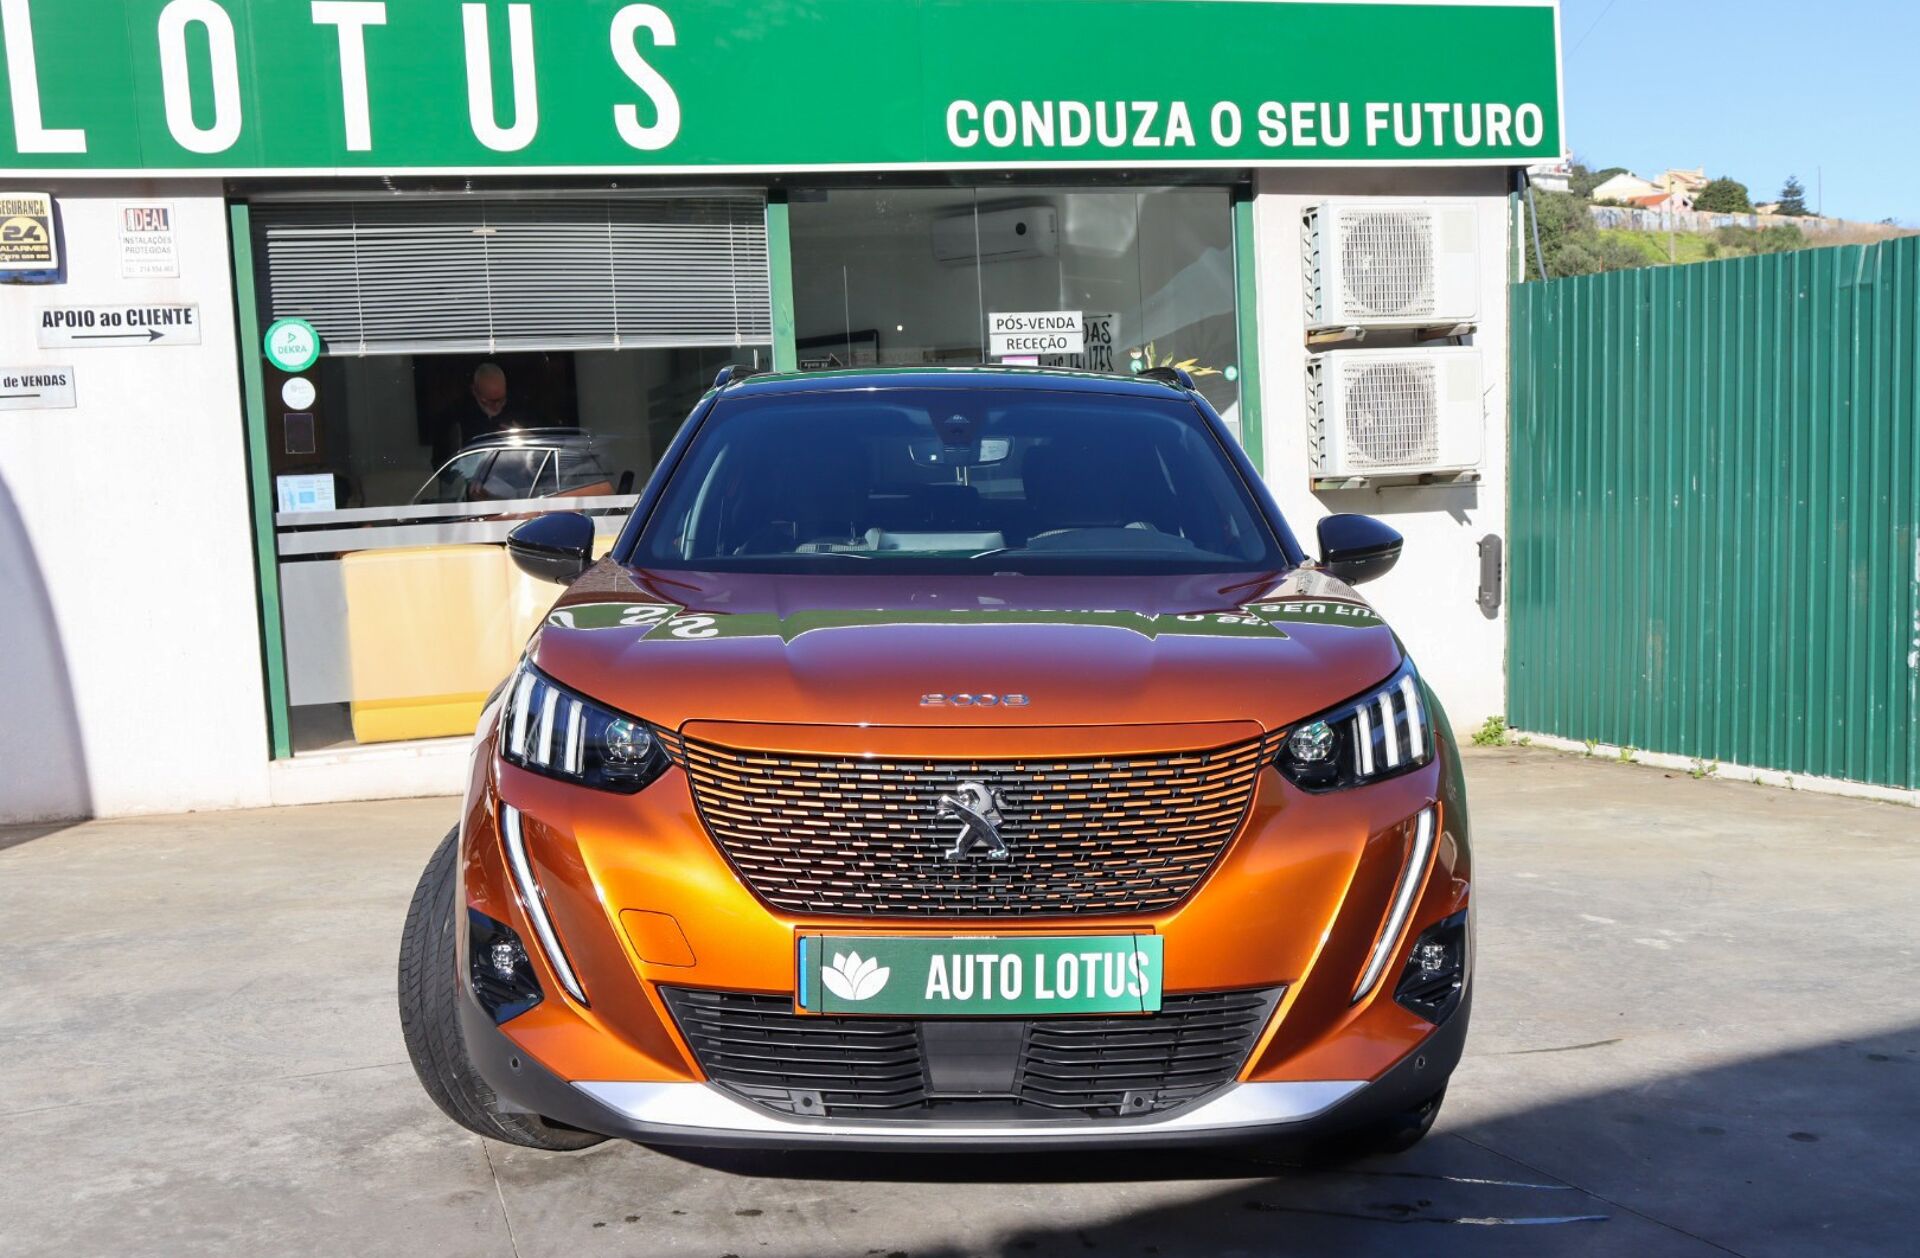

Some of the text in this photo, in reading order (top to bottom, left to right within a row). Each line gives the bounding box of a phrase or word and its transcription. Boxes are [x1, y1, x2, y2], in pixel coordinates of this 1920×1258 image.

[2, 0, 681, 153] LOTUS
[946, 100, 1543, 147] CONDUZA O SEU FUTURO
[2, 225, 41, 241] 24
[42, 308, 192, 328] APOIO ao CLIENTE
[996, 315, 1076, 330] PÓS-VENDA
[278, 345, 307, 354] DEKRA
[1006, 335, 1067, 352] RECEÇÃO
[3, 375, 66, 387] de VENDAS
[920, 693, 1030, 707] 2008
[925, 951, 1150, 1000] AUTO LOTUS
